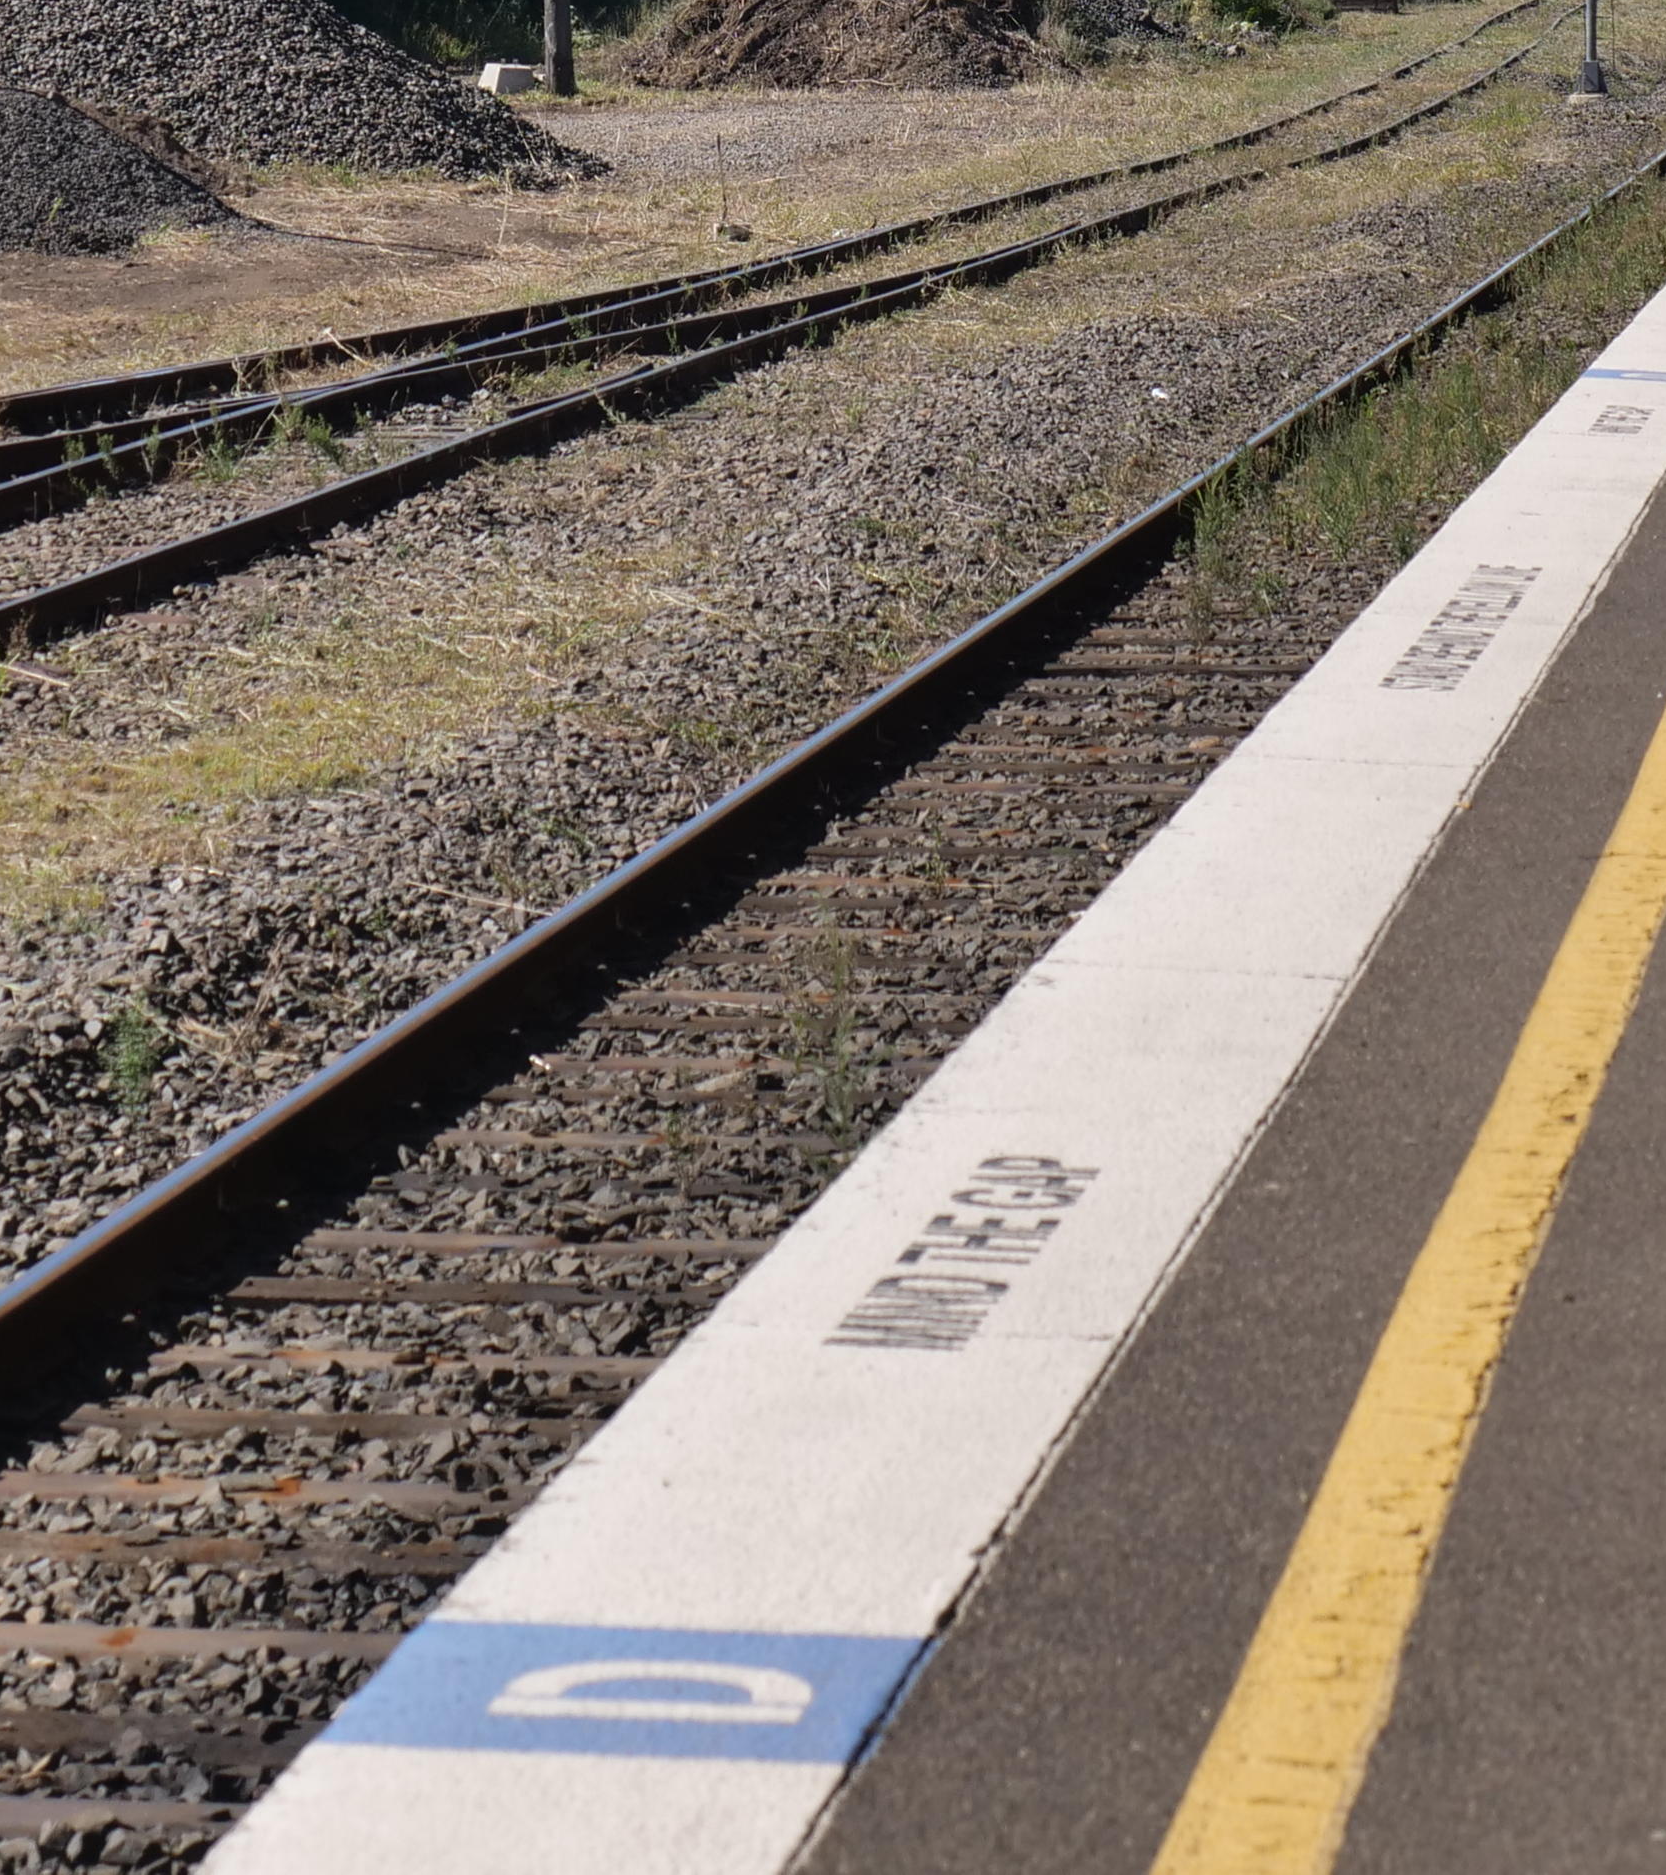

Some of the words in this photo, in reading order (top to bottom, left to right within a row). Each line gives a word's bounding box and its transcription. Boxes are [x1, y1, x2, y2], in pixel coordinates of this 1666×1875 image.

[951, 1154, 1101, 1209] GAP
[895, 1214, 1060, 1265] THE
[823, 1273, 1010, 1351] MIND
[488, 1659, 814, 1724] D
